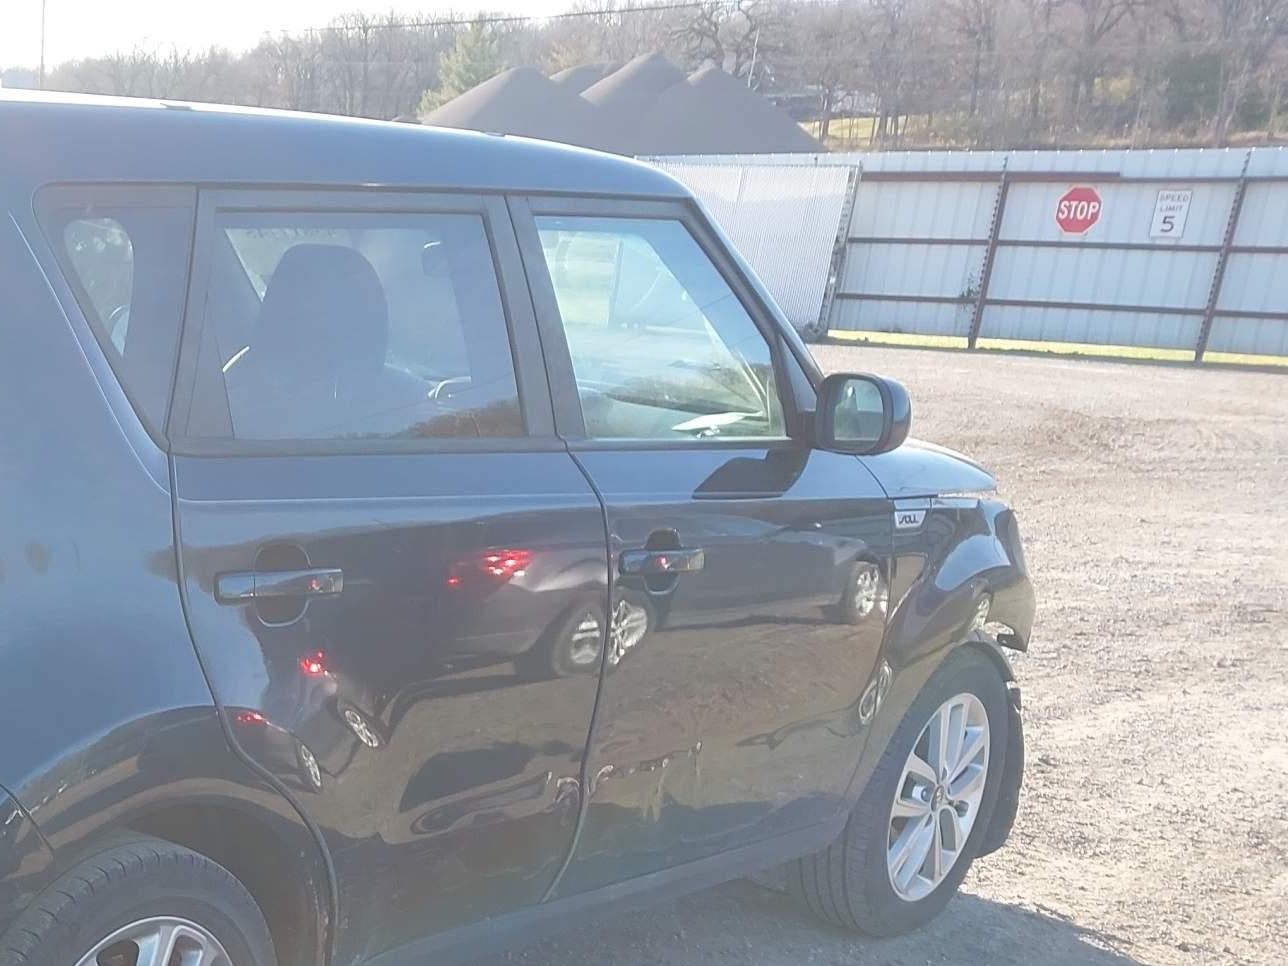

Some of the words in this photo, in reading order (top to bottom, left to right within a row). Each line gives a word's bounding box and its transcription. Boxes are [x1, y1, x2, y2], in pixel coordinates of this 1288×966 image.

[1160, 193, 1189, 203] SPEED
[1058, 200, 1099, 220] STOP
[1159, 205, 1184, 213] LIMIT
[1160, 215, 1175, 233] 5
